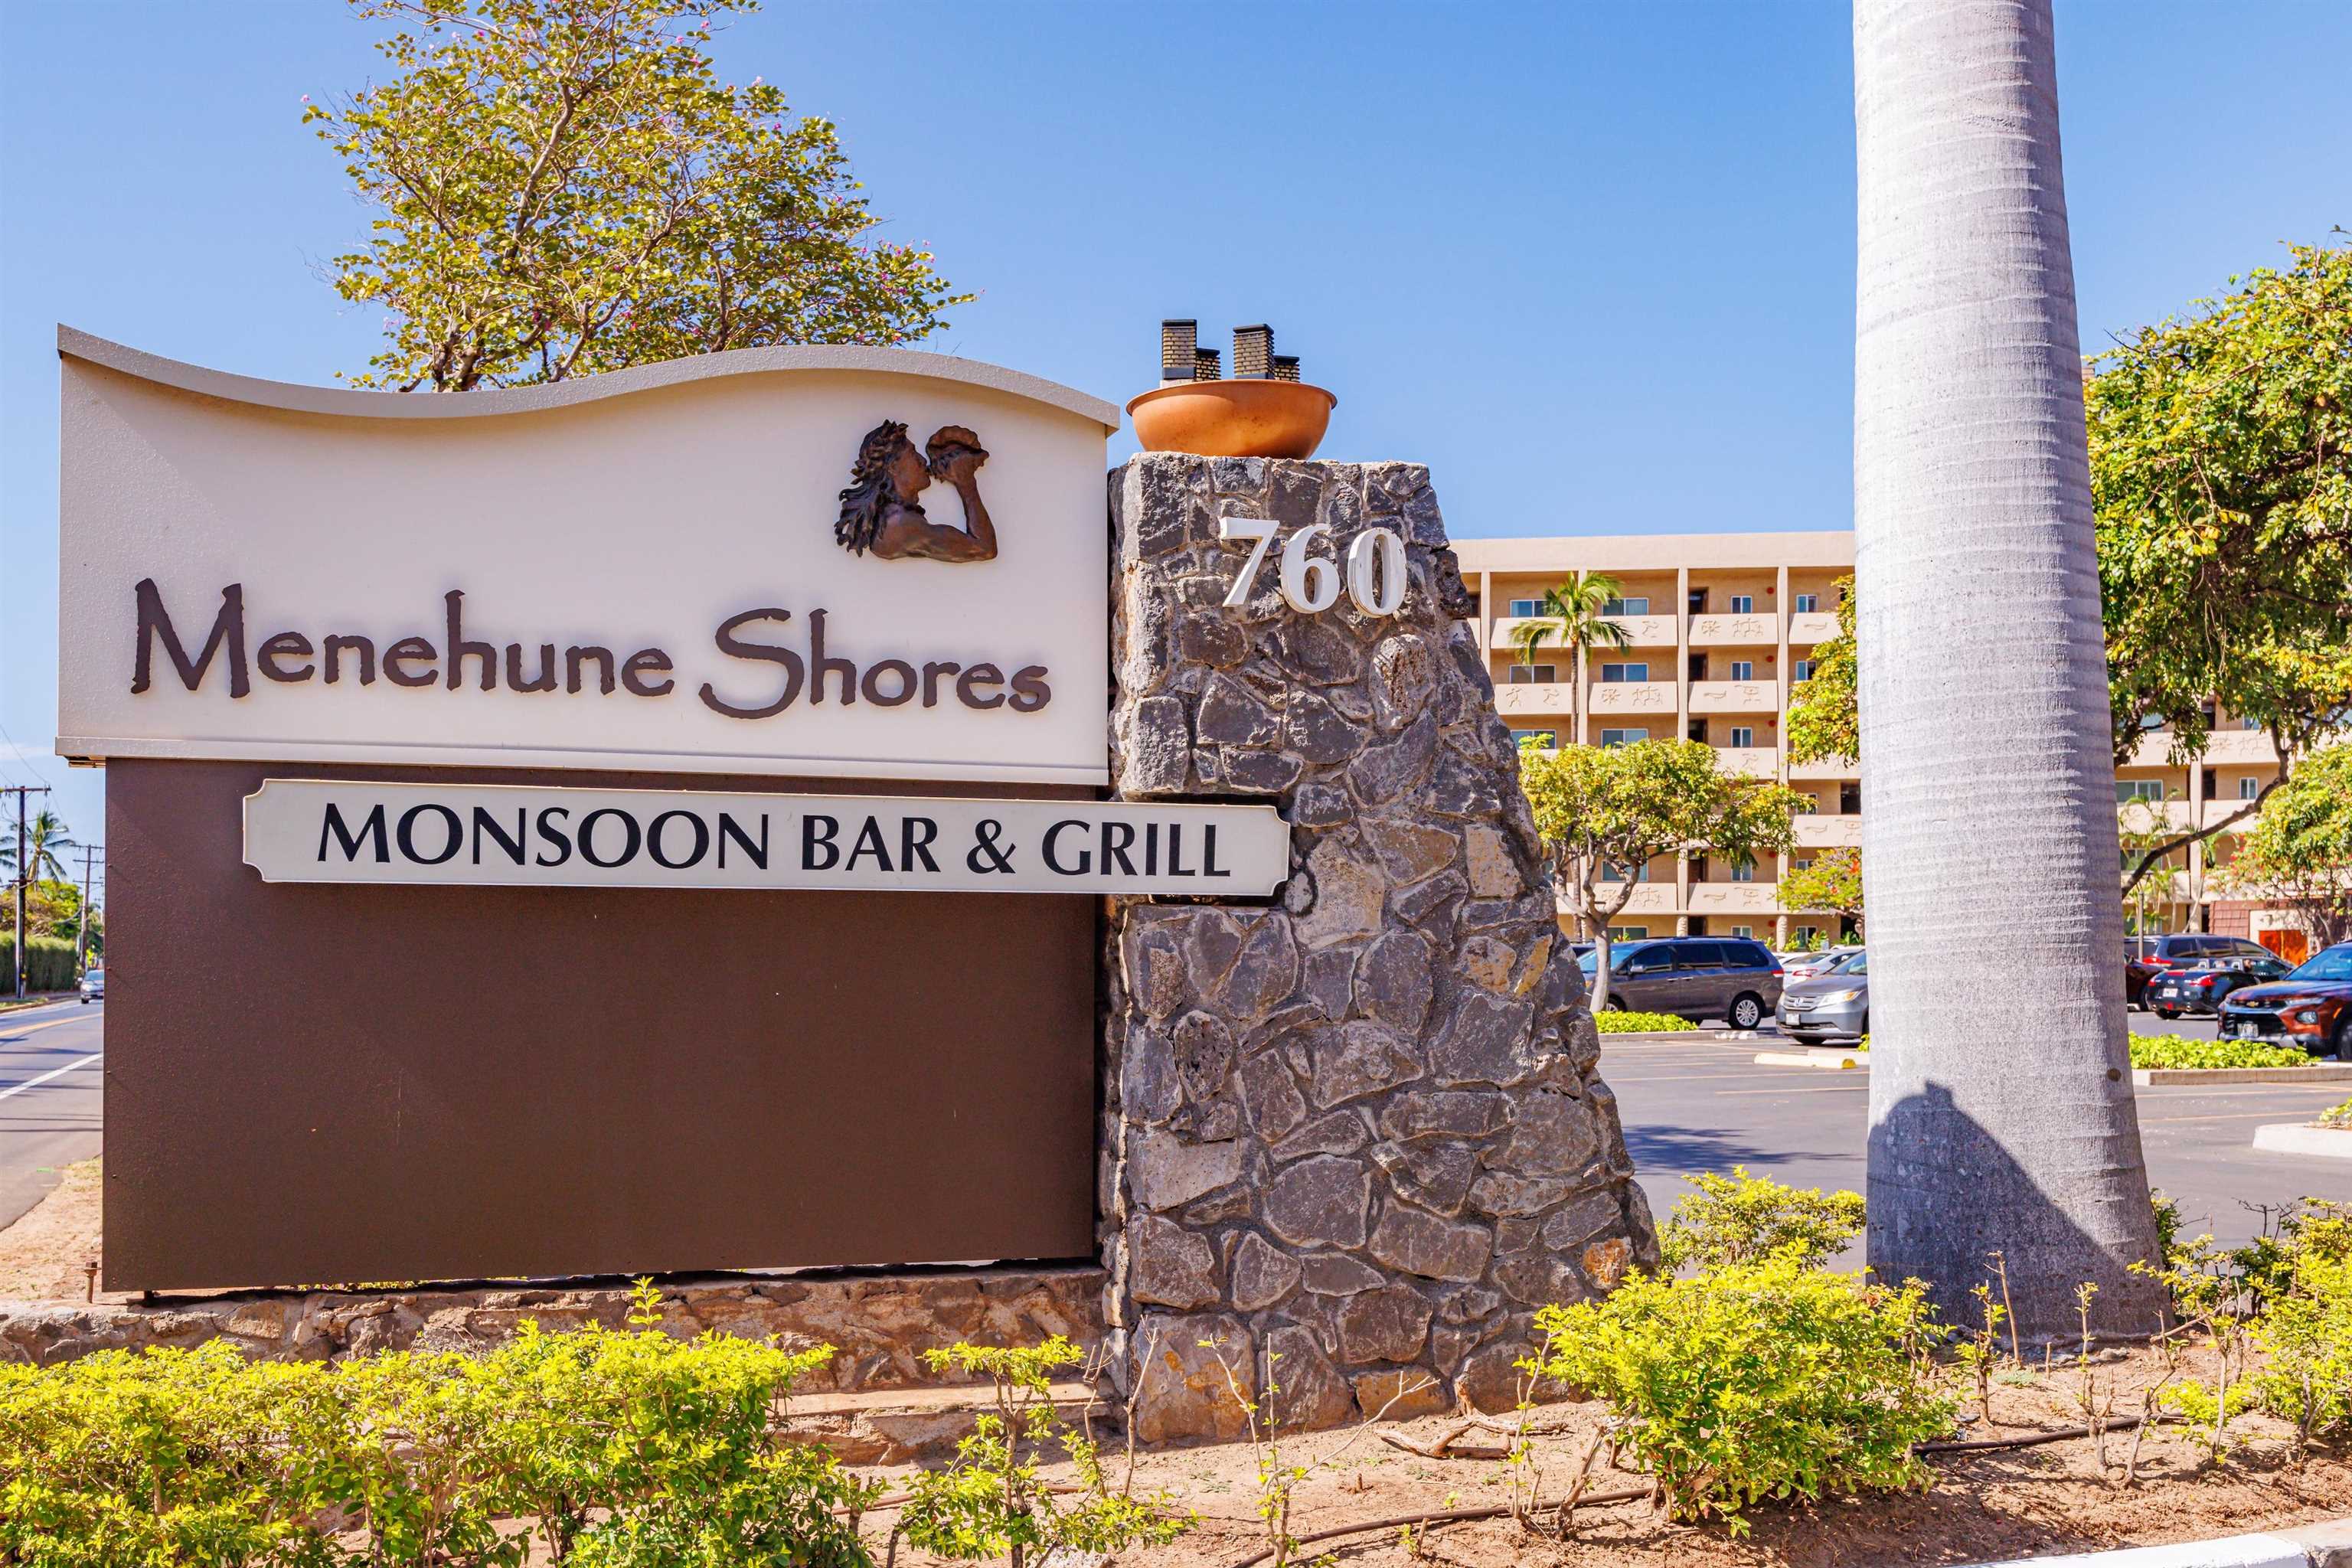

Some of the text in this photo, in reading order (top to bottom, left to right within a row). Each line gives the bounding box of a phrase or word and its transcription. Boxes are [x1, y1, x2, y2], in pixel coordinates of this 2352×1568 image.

[1220, 517, 1408, 619] 760
[130, 577, 1052, 720] Menehune Shores
[317, 802, 1231, 877] MONSOON BAR & GRILL
